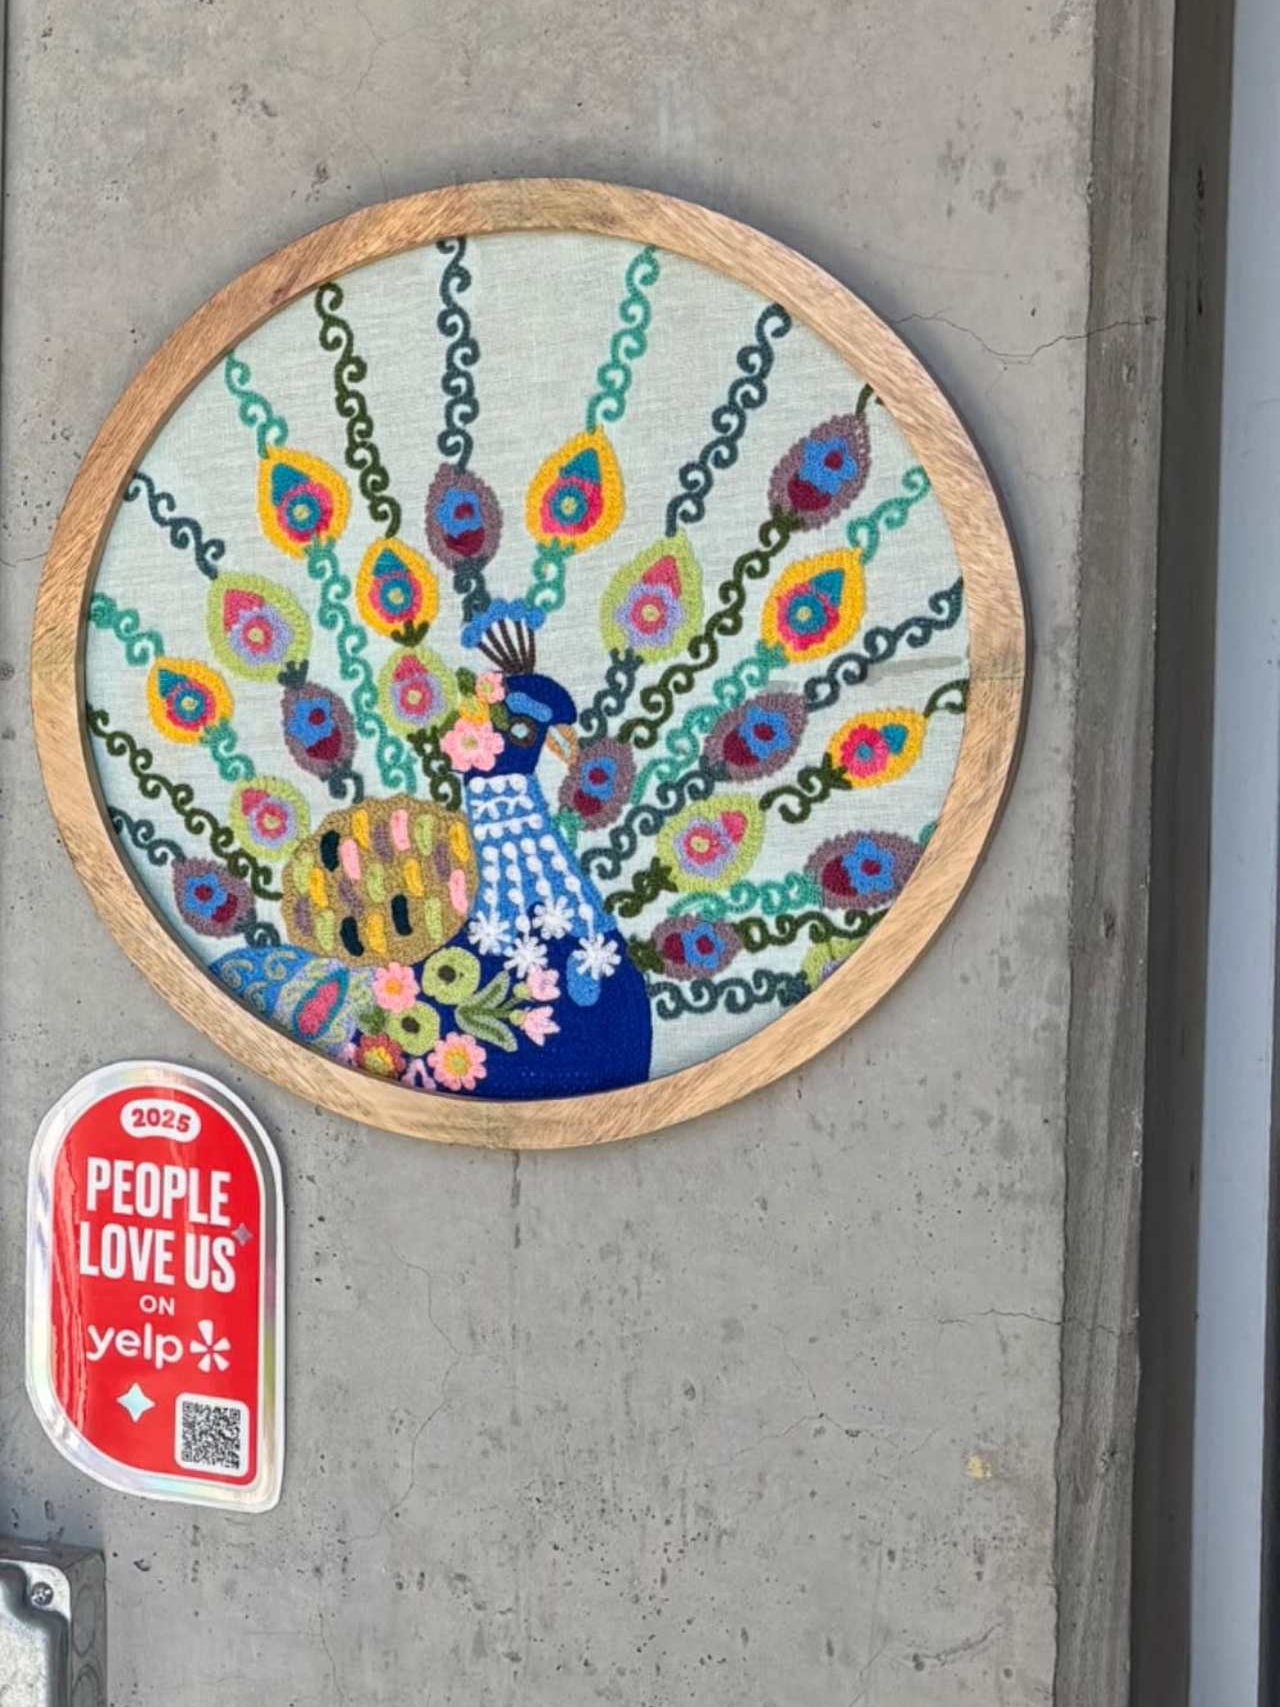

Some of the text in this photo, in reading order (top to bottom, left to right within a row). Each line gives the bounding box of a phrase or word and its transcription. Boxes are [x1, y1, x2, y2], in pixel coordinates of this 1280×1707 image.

[130, 1106, 192, 1134] 2025
[86, 1156, 232, 1228] PEOPLE
[79, 1221, 236, 1294] LOVE US
[139, 1294, 175, 1317] ON
[85, 1322, 184, 1370] yelp
